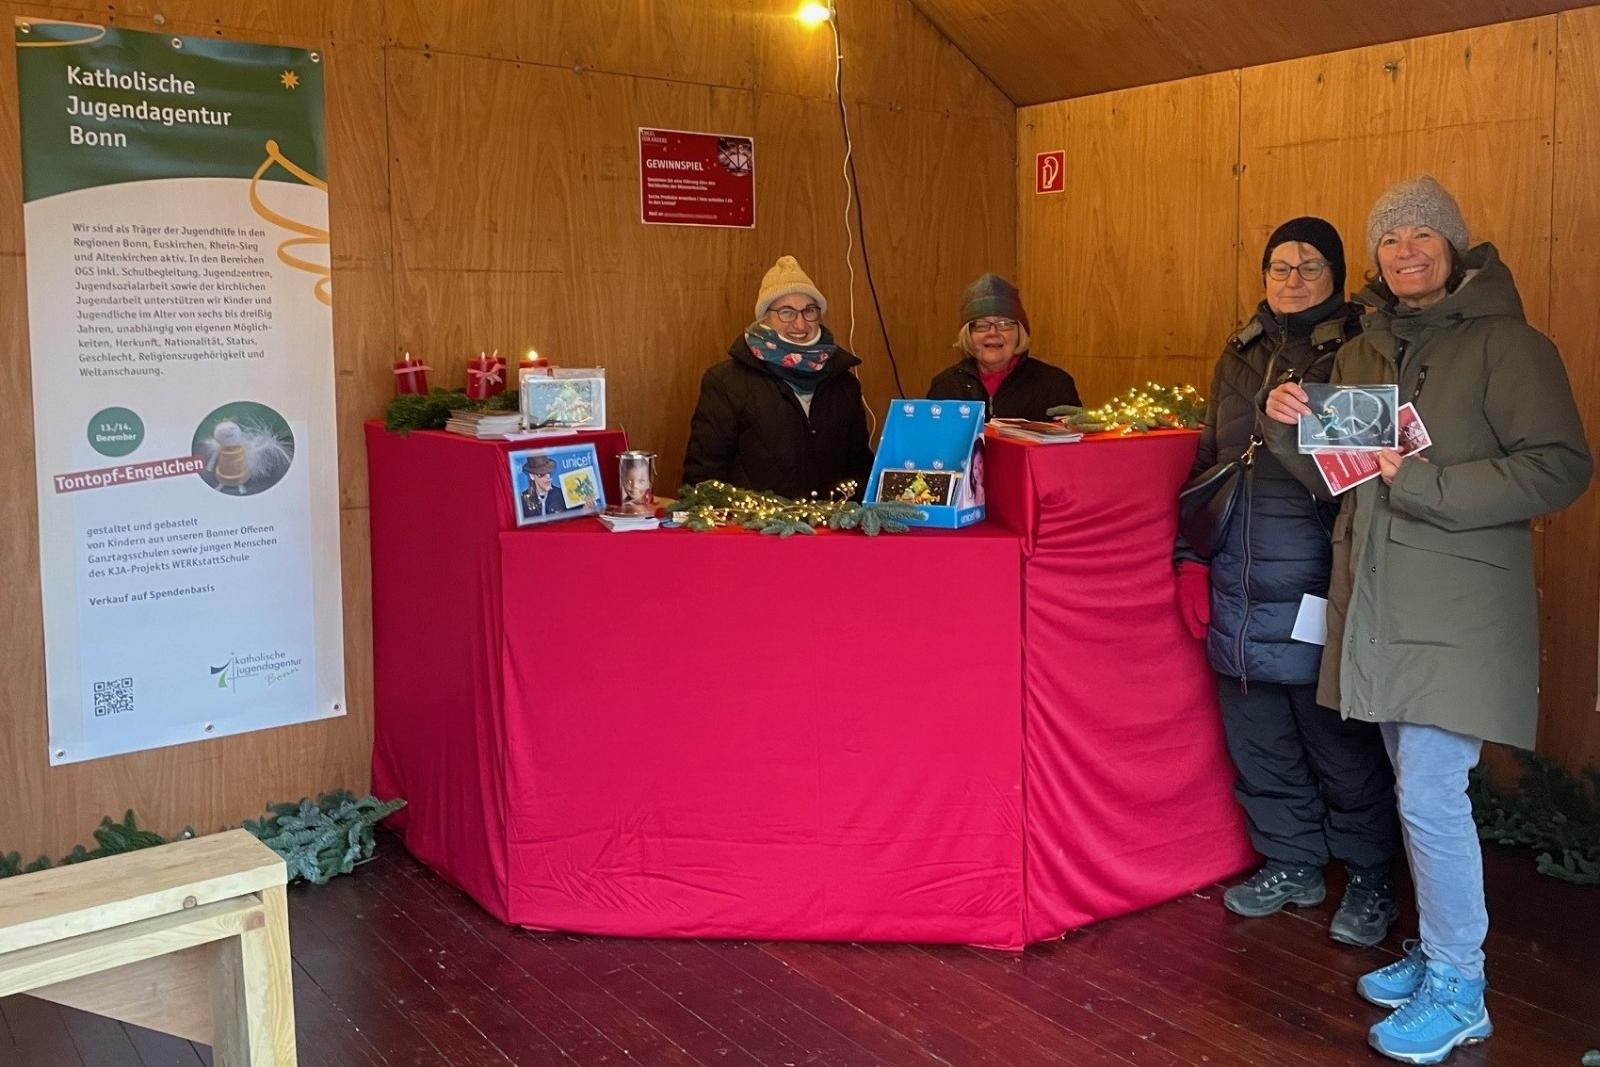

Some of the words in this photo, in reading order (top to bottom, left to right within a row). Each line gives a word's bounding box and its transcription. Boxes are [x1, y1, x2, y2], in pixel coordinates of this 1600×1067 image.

[66, 65, 196, 94] Katholische
[66, 95, 232, 127] Jugendagentur
[69, 125, 127, 148] Bonn
[646, 159, 704, 171] GEWINNSPIEL
[72, 223, 89, 232] Wir
[93, 224, 113, 233] sind
[116, 225, 129, 233] als
[132, 225, 161, 236] Träger
[164, 226, 179, 234] der
[182, 226, 235, 237] Jugendhilfe
[238, 228, 246, 236] in
[249, 229, 265, 237] den
[74, 238, 120, 248] Regionen
[123, 239, 151, 248] Bonn,
[153, 240, 207, 249] Euskirchen,
[210, 241, 258, 252] Rhein-Sieg
[74, 253, 93, 261] und
[96, 253, 157, 261] Altenkirchen
[160, 254, 186, 262] aktiv.
[189, 255, 199, 263] In
[201, 255, 218, 263] den
[221, 255, 264, 264] Bereichen
[75, 267, 94, 276] OGS
[97, 267, 119, 276] inkl.
[203, 269, 272, 279] Jugendzentren,
[75, 281, 169, 292] Jugendsozialarbeit
[171, 282, 197, 290] sowie
[200, 282, 214, 290] der
[217, 282, 266, 290] kirchlichen
[76, 296, 142, 306] Jugendarbeit
[144, 296, 204, 304] unterstützen
[223, 296, 253, 304] Kinder
[255, 296, 272, 304] und
[76, 310, 136, 320] Jugendliche
[139, 310, 151, 318] im
[154, 310, 176, 318] Alter
[197, 310, 222, 318] sechs
[225, 310, 238, 318] bis
[240, 310, 272, 319] dreißig
[77, 324, 114, 334] Jahren,
[117, 324, 174, 334] unabhängig
[195, 324, 231, 334] eigenen
[233, 322, 272, 332] Möglich-
[79, 339, 112, 348] keiten,
[226, 337, 257, 345] Status,
[139, 350, 246, 361] Religionszugehörigkeit
[247, 350, 264, 358] und
[80, 366, 163, 376] Weltanschauung.
[100, 423, 131, 433] 13./14.
[96, 432, 137, 443] Dezember
[562, 453, 592, 469] unicef
[56, 459, 204, 491] Tontopf-Engelchen
[87, 525, 131, 537] gestaltet
[133, 522, 152, 531] und
[154, 518, 198, 531] gebastelt
[108, 537, 146, 548] Kindern
[167, 533, 204, 542] unseren
[206, 529, 239, 538] Bonner
[241, 525, 274, 534] Offenen
[88, 548, 169, 563] Ganztagsschulen
[172, 546, 198, 555] sowie
[200, 543, 231, 554] jungen
[234, 538, 277, 549] Menschen
[89, 569, 105, 578] des
[108, 563, 170, 575] KJA-Projekts
[172, 553, 250, 568] WERKstattSchule
[89, 594, 128, 606] Verkauf
[132, 591, 147, 601] auf
[149, 584, 216, 600] Spendenbasis
[235, 650, 286, 665] katholische
[236, 658, 302, 676] jugendagentur
